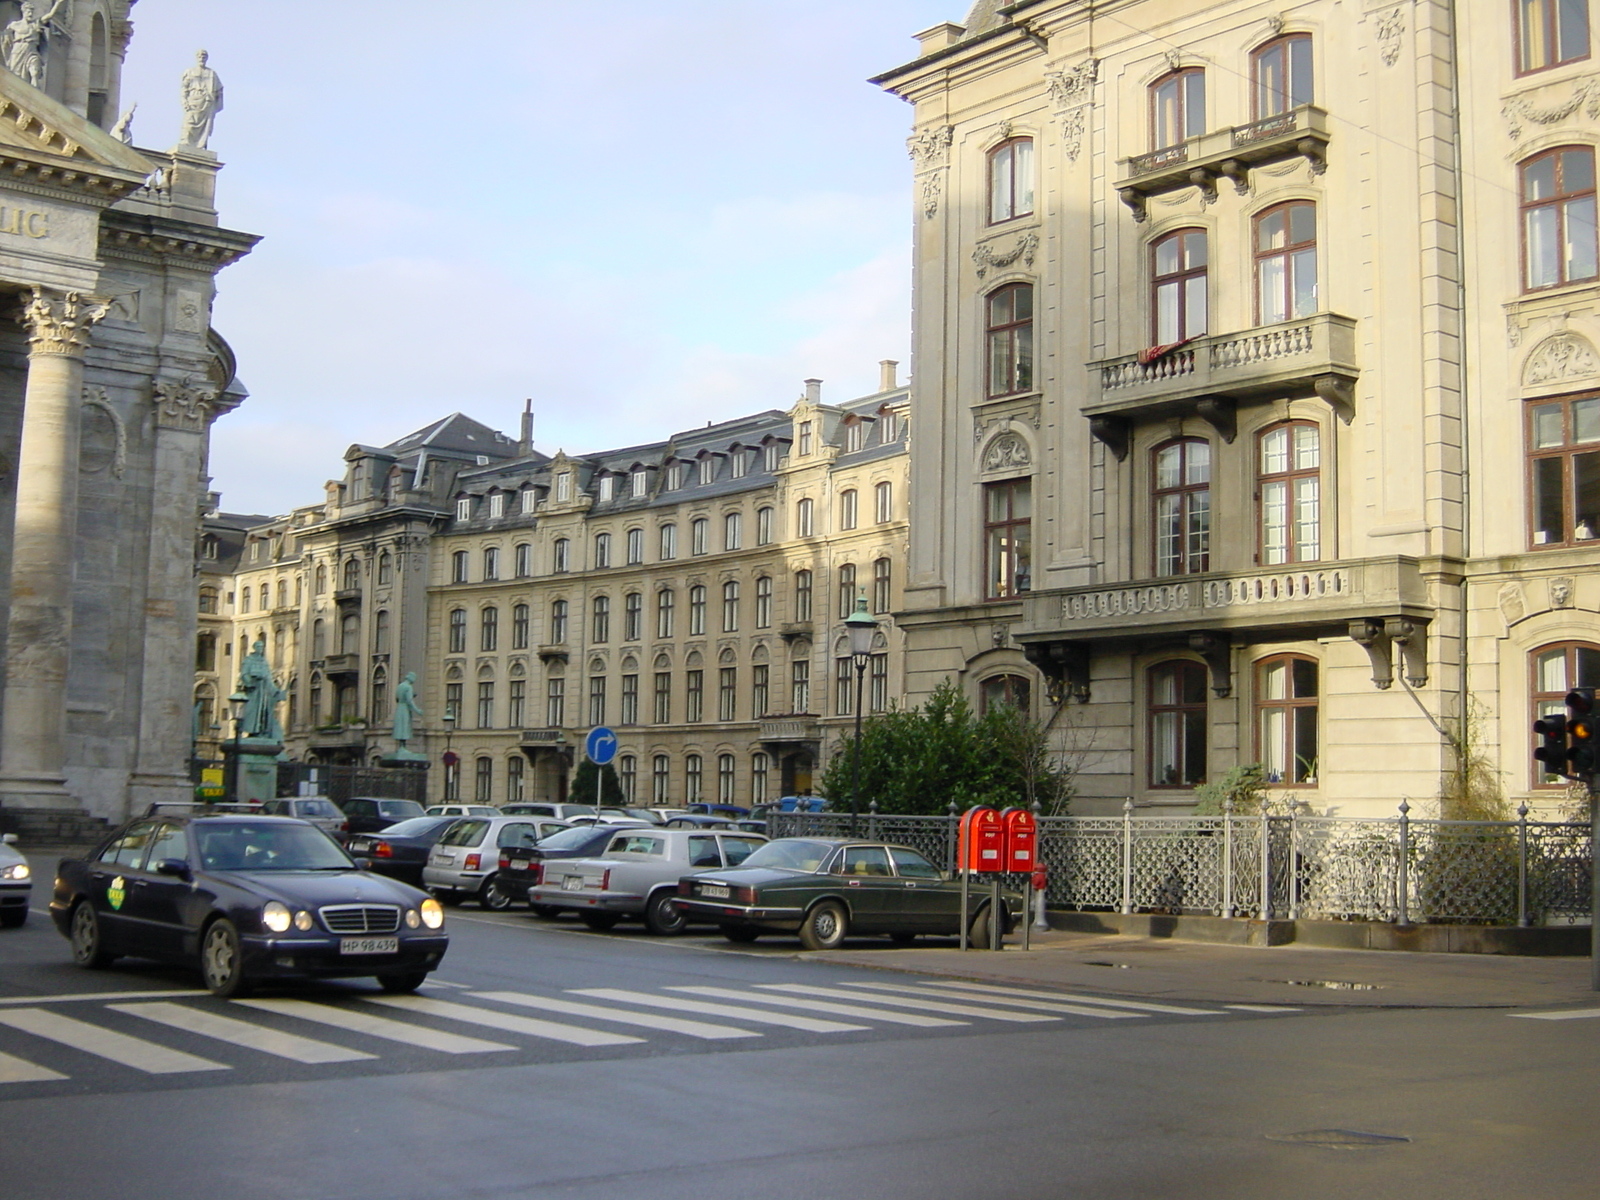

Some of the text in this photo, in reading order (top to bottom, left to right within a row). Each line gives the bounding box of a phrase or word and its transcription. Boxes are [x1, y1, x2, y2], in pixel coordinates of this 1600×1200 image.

[343, 940, 396, 952] HP 98 439
